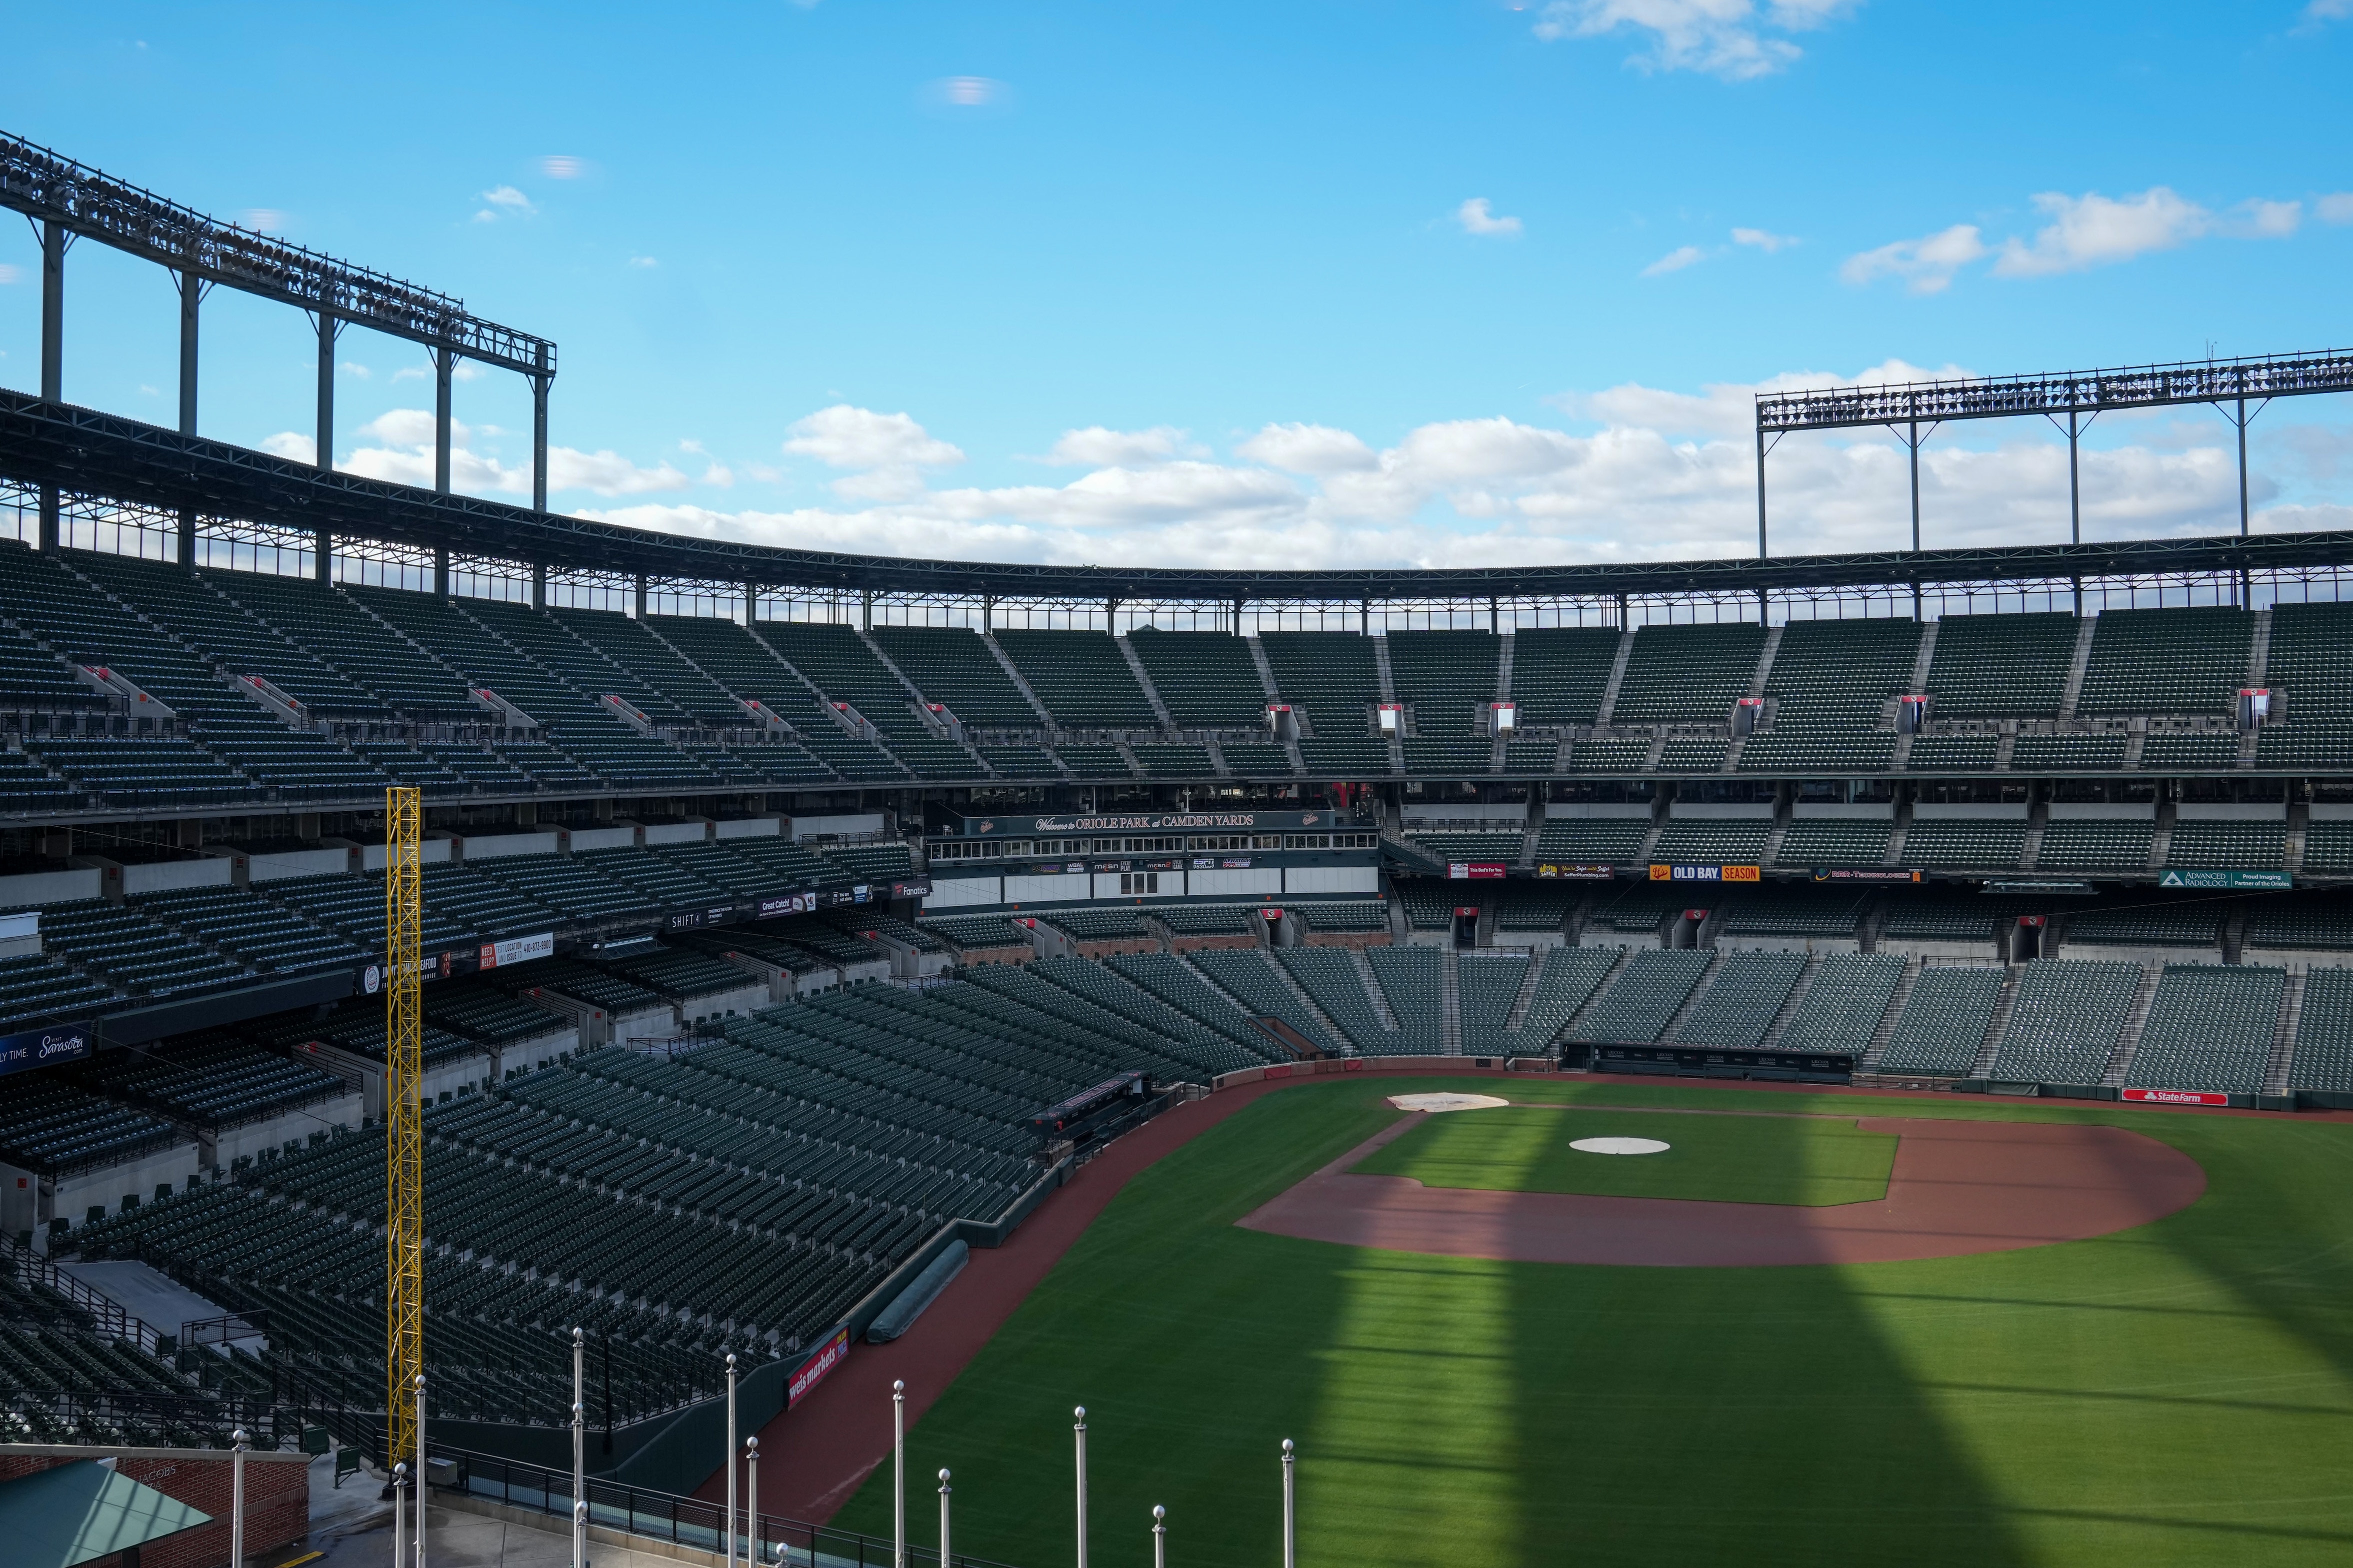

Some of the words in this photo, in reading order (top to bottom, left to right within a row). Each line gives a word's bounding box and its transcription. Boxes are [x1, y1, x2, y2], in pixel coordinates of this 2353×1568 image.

[1036, 817, 1068, 831] Welcome
[1076, 818, 1118, 829] ORIOLE
[1120, 817, 1150, 828] PARK
[1162, 816, 1213, 827] CAMDEN
[1215, 815, 1254, 826] YARDS
[1674, 867, 1695, 879] OLD
[1725, 868, 1756, 879] SEASON
[904, 886, 927, 896] Fanatics
[775, 899, 790, 908] Catch!
[482, 946, 492, 957] NEED
[496, 945, 504, 954] TEXT
[505, 941, 522, 952] LOCATION
[524, 939, 551, 953] 410-873-9900
[482, 957, 494, 967] HELP?
[506, 952, 516, 961] ISSUE
[419, 957, 436, 971] EAFOOD
[39, 1036, 83, 1058] Sarasota
[9, 1048, 28, 1060] TIME.
[789, 1374, 806, 1400] weis
[806, 1348, 835, 1385] markets
[138, 1465, 176, 1484] JACOBS
